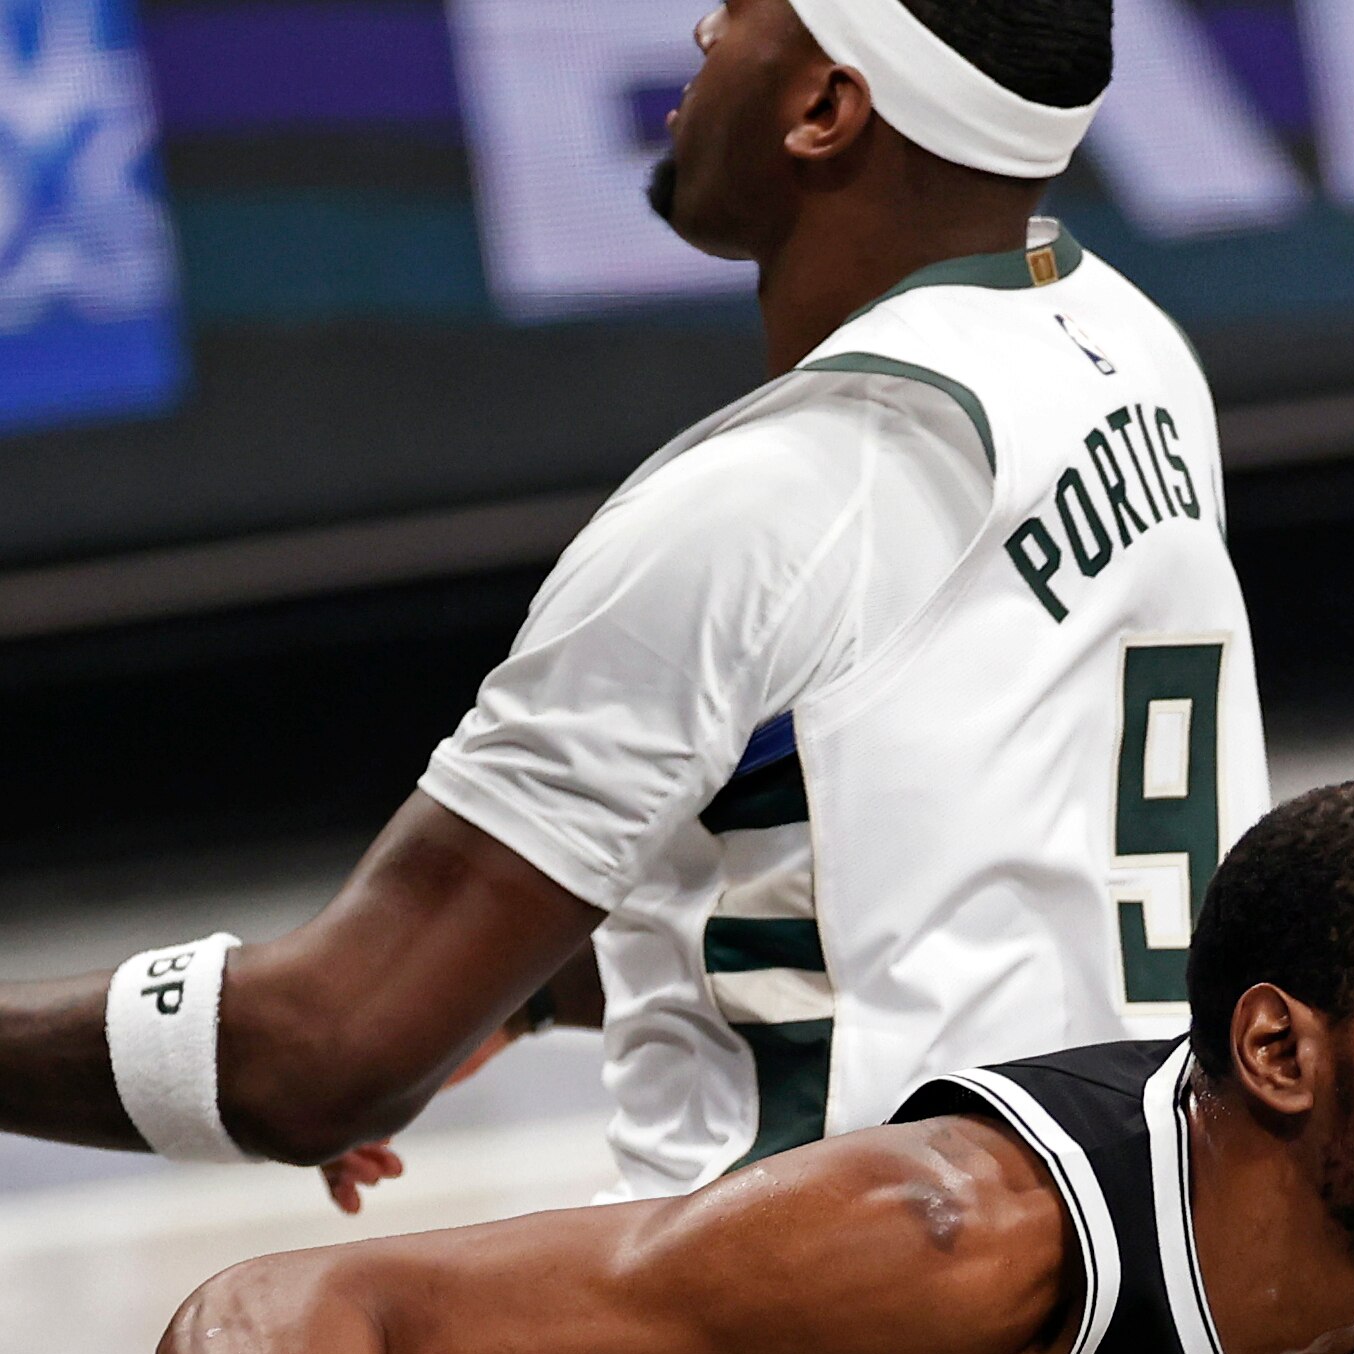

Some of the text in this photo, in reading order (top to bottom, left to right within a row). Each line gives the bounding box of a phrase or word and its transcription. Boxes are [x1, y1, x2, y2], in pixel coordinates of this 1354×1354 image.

[1003, 404, 1201, 623] PORTIS
[1111, 630, 1233, 1016] 9
[140, 952, 195, 1014] BP
